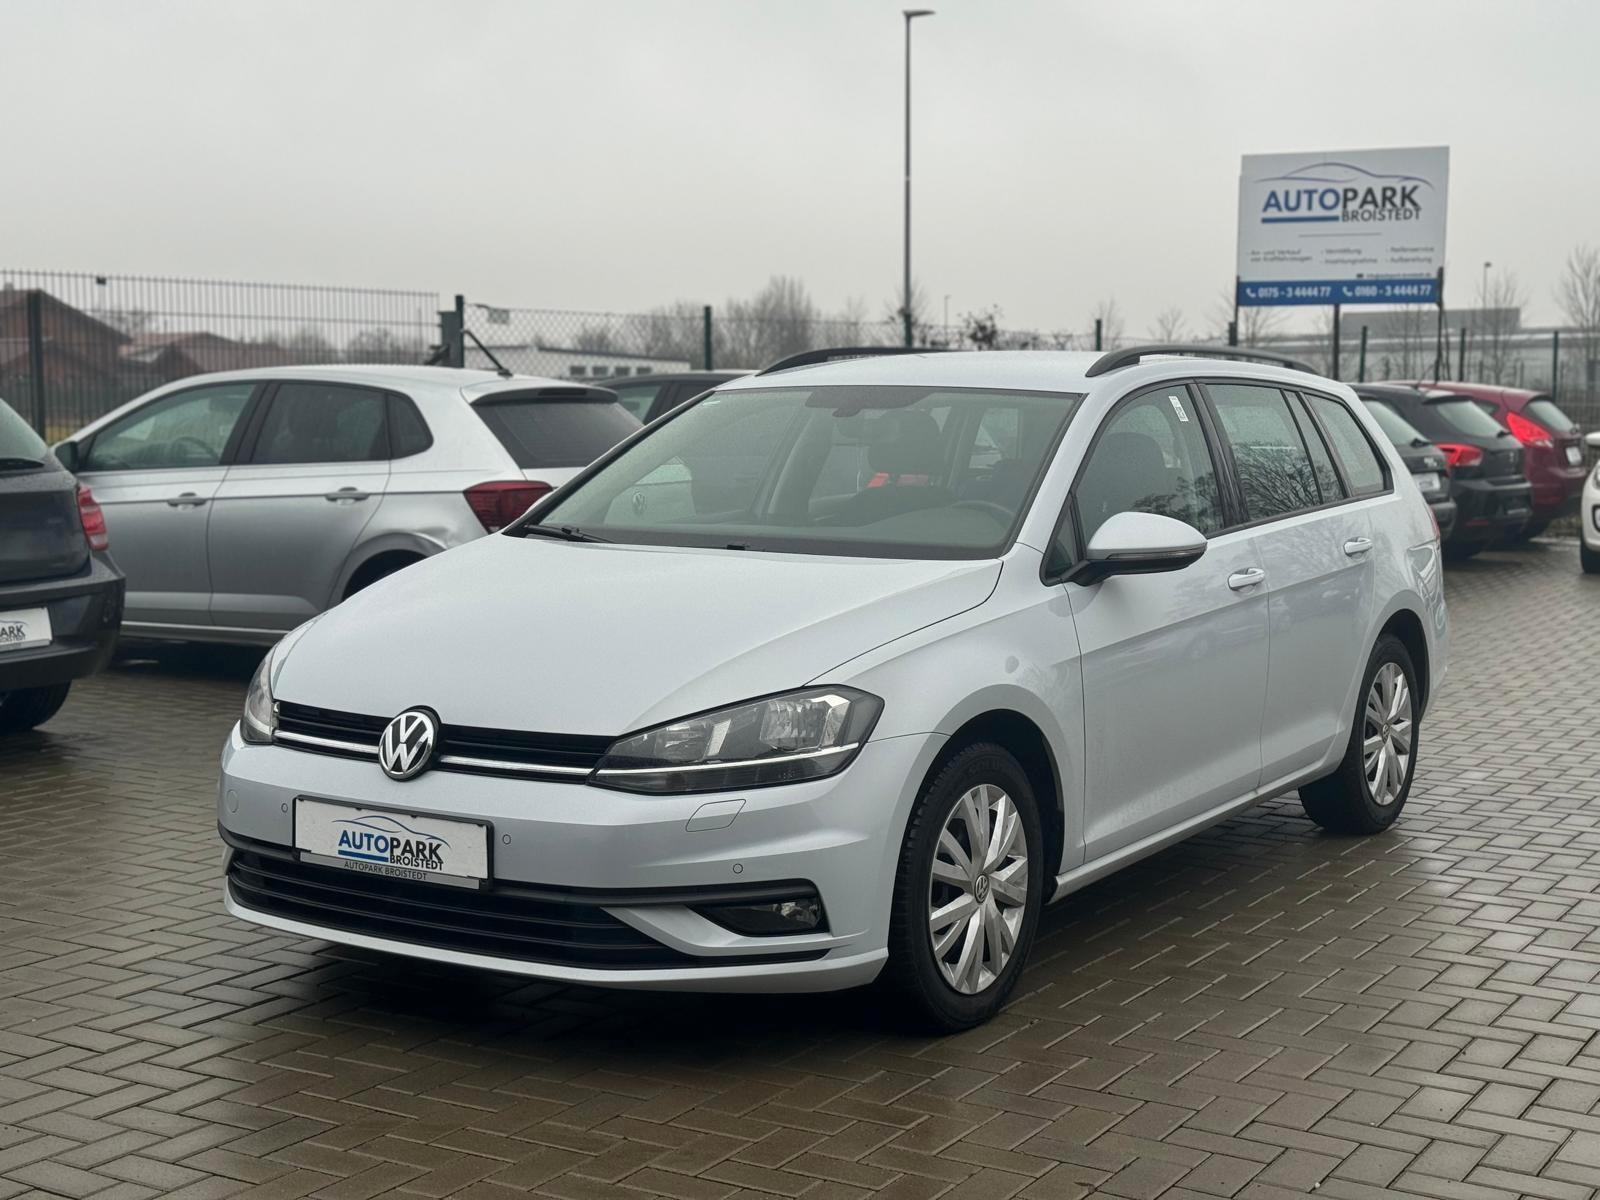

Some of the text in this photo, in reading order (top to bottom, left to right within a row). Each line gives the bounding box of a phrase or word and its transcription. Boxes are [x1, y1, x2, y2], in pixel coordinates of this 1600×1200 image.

[1262, 185, 1421, 213] AUTOPARK
[1342, 207, 1421, 222] BROISTEDT
[1258, 286, 1280, 298] 0175
[338, 830, 442, 861] AUTOPARK
[343, 861, 428, 881] AUTOPARK BROISTEDT
[389, 854, 443, 871] BROISTEDT
